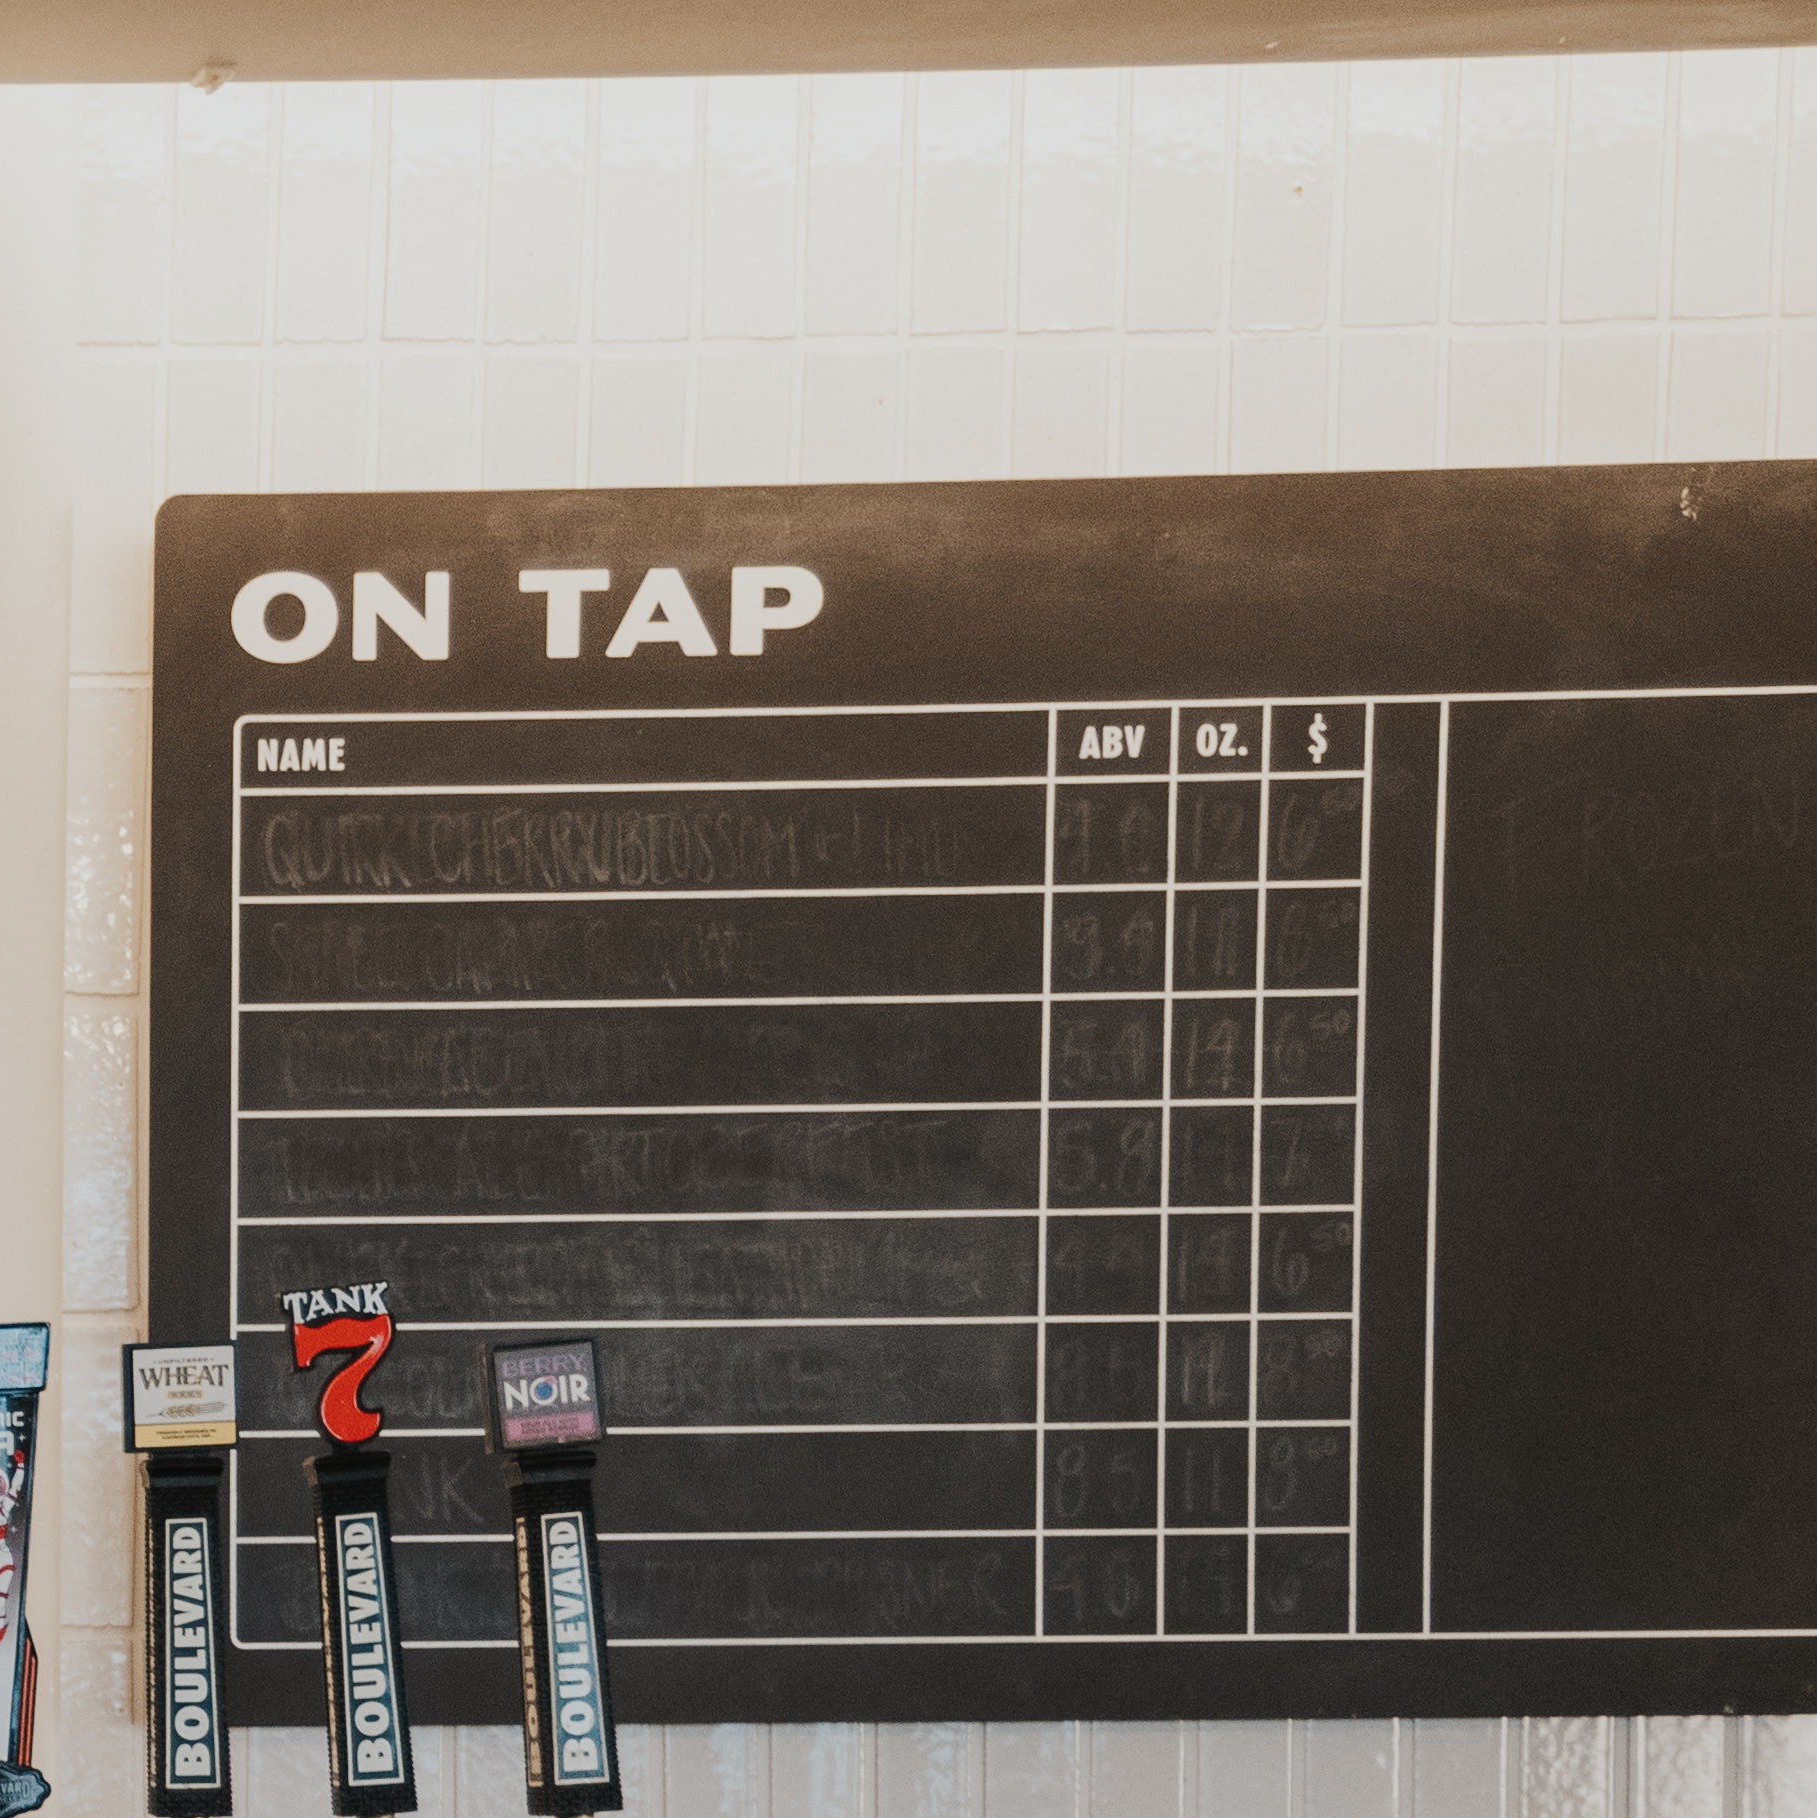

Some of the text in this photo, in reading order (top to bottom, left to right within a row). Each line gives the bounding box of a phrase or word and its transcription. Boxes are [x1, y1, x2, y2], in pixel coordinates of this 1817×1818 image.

[230, 561, 825, 665] ON TAP
[257, 737, 346, 772] NAME
[1078, 724, 1146, 760] ABV
[1195, 722, 1249, 758] OZ.
[1307, 712, 1328, 764] $
[282, 1281, 389, 1325] TANK
[138, 1364, 229, 1391] WHEAT
[294, 1314, 392, 1442] 7
[503, 1373, 592, 1412] NOIR
[171, 1525, 212, 1777] BOULEVARD
[345, 1521, 394, 1774] BOULEVARD
[549, 1521, 599, 1774] BOULEVARD
